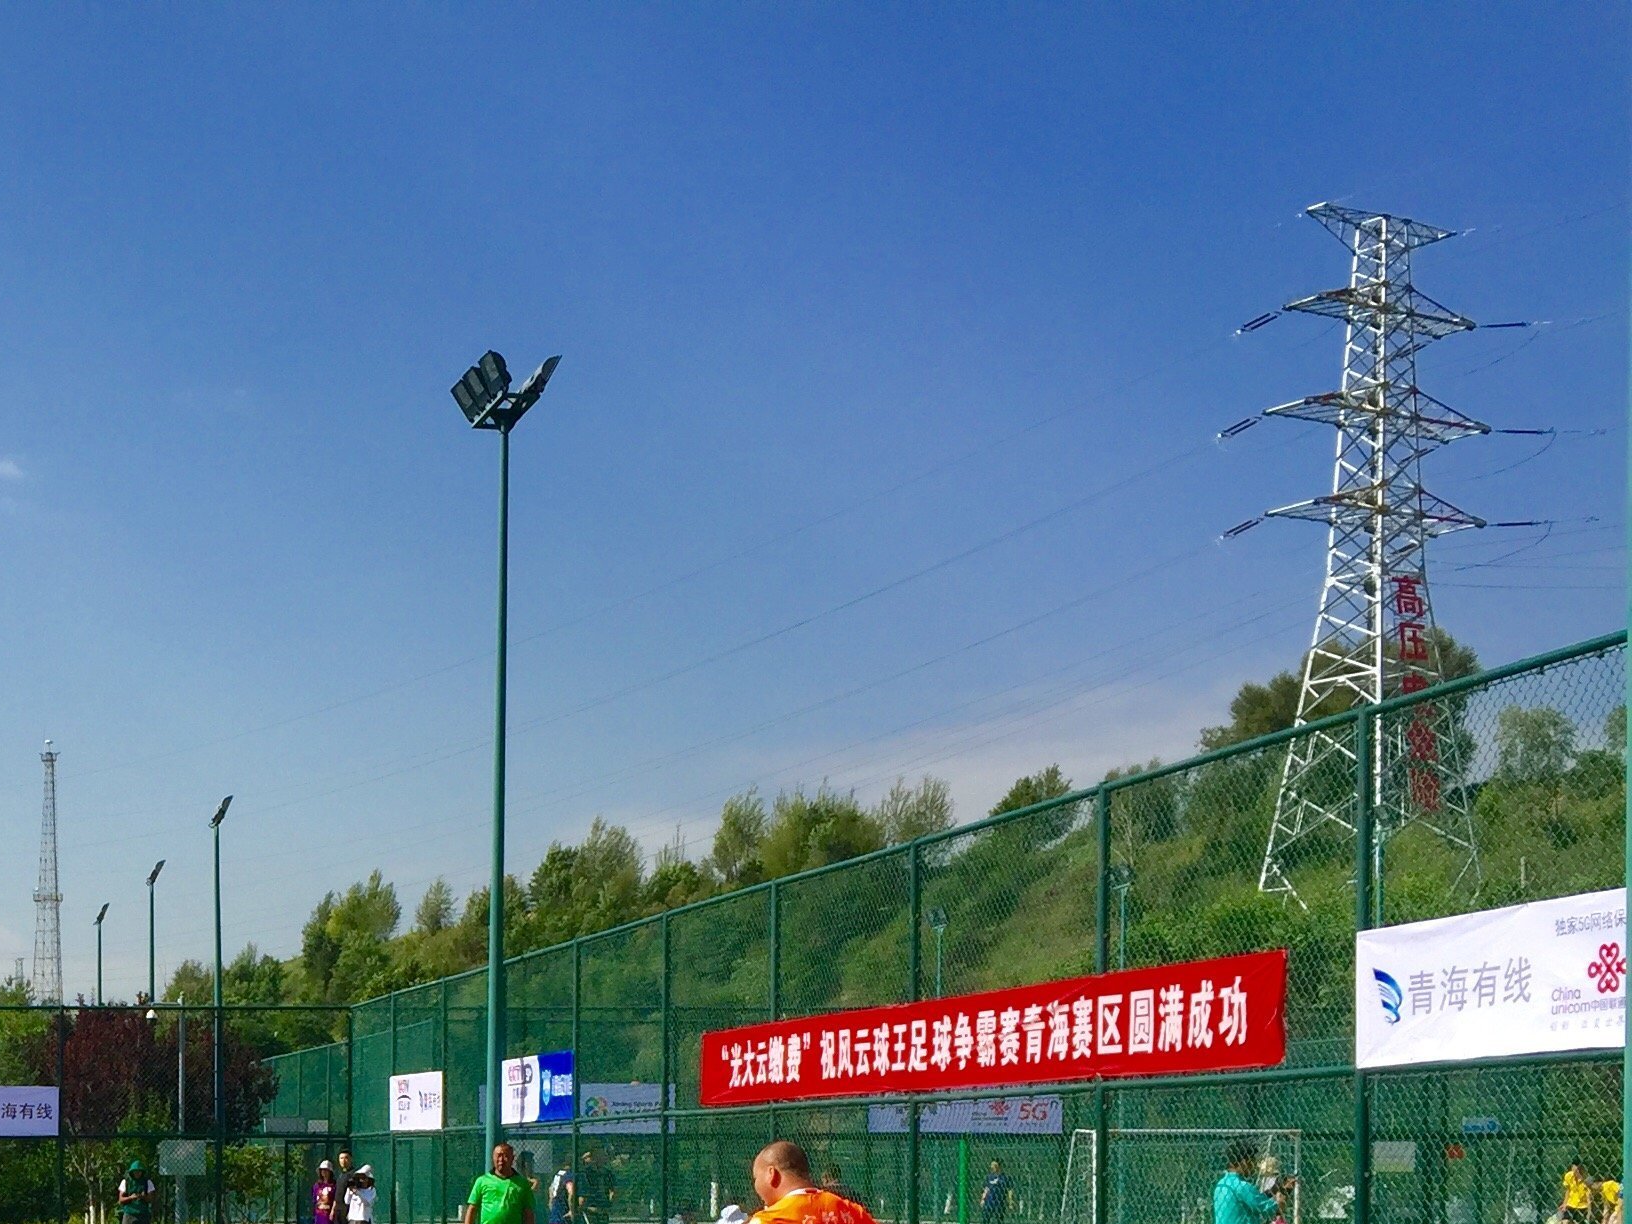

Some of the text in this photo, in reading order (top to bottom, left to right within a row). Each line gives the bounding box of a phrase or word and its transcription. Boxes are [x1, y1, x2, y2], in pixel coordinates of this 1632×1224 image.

[1408, 956, 1532, 1016] 青海有线
[1551, 987, 1581, 1001] China
